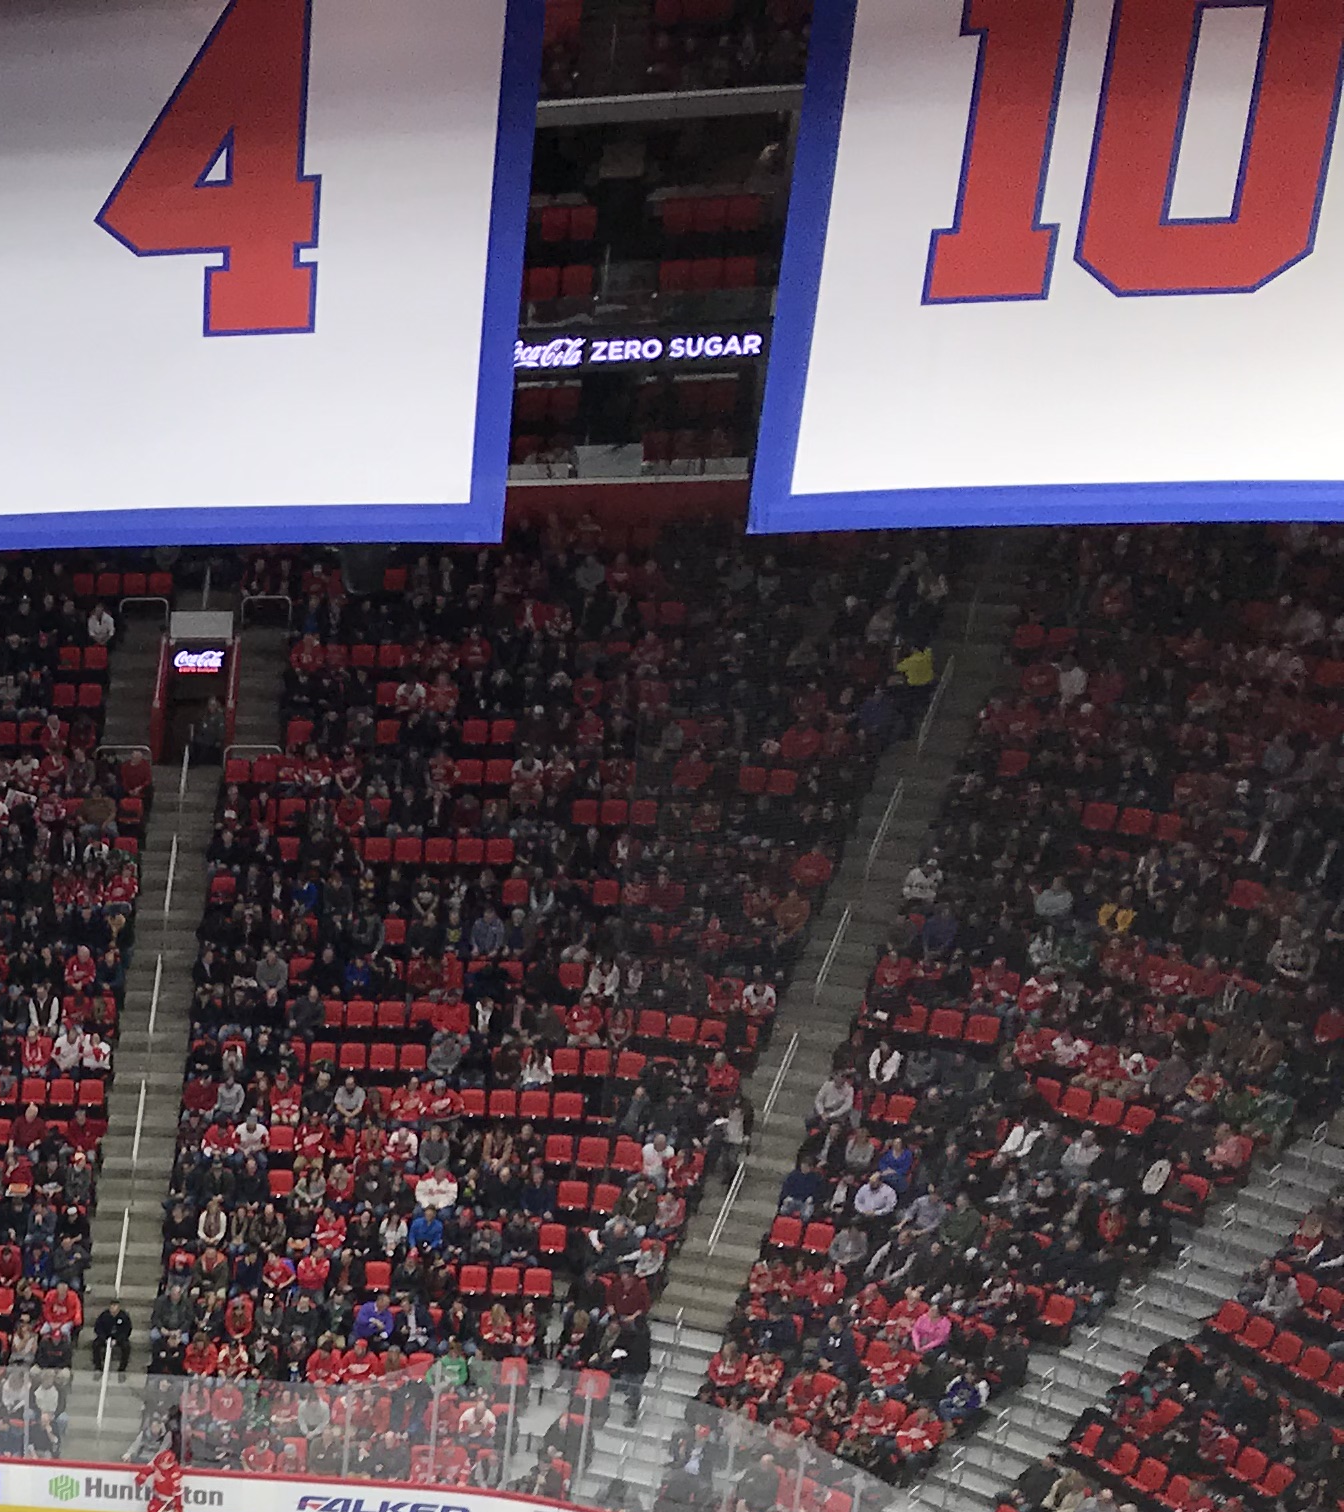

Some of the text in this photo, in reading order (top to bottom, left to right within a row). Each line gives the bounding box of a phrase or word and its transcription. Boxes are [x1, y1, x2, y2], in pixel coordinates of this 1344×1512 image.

[93, 0, 322, 338] 4
[921, 0, 1344, 305] 10
[589, 338, 663, 362] ZERO
[669, 333, 762, 358] SUGAR
